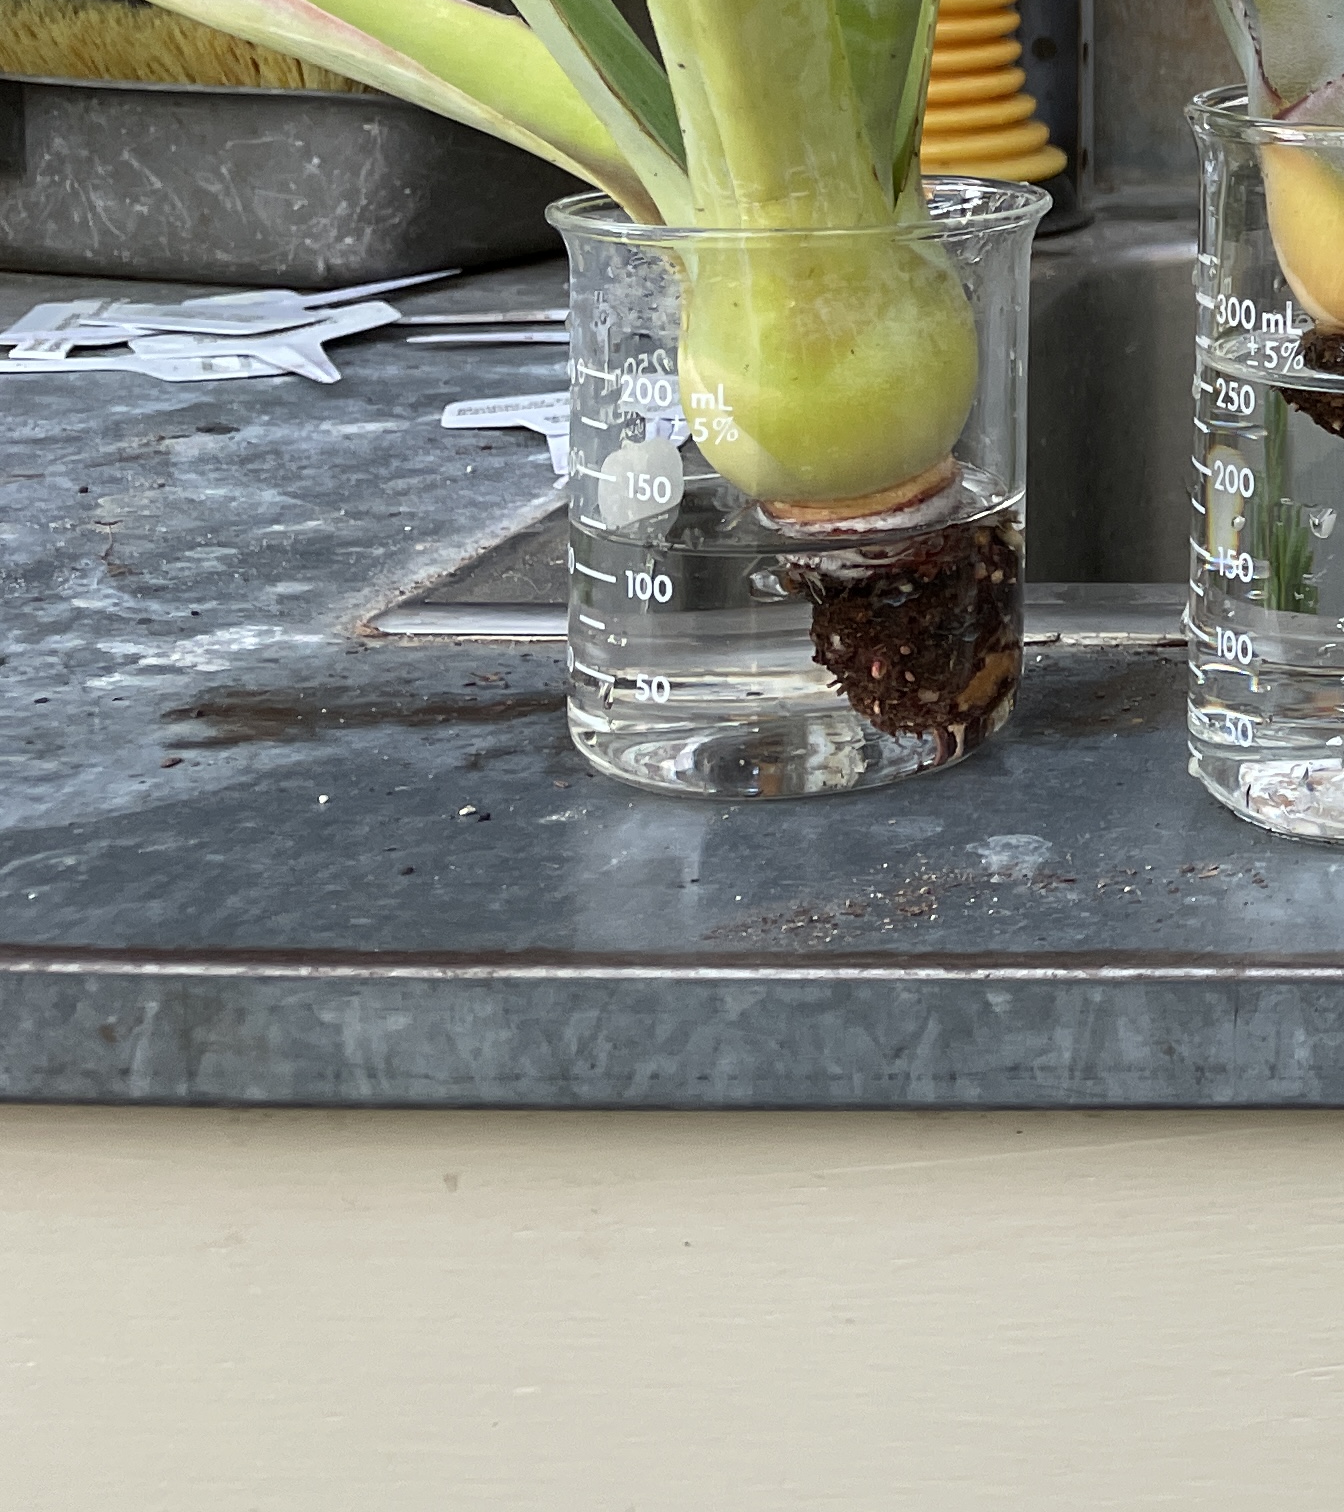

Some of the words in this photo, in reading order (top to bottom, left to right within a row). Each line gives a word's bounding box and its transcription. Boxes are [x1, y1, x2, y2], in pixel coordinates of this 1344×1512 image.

[1215, 297, 1256, 331] 300
[1261, 304, 1303, 336] mL
[618, 374, 674, 408] 200
[690, 383, 733, 412] mL
[1216, 377, 1256, 415] 250
[626, 472, 672, 504] 150
[1214, 460, 1255, 498] 200
[1216, 545, 1254, 583] 150
[625, 569, 674, 603] 100
[1216, 625, 1253, 665] 100
[634, 673, 671, 704] 50
[1223, 714, 1253, 748] 50
